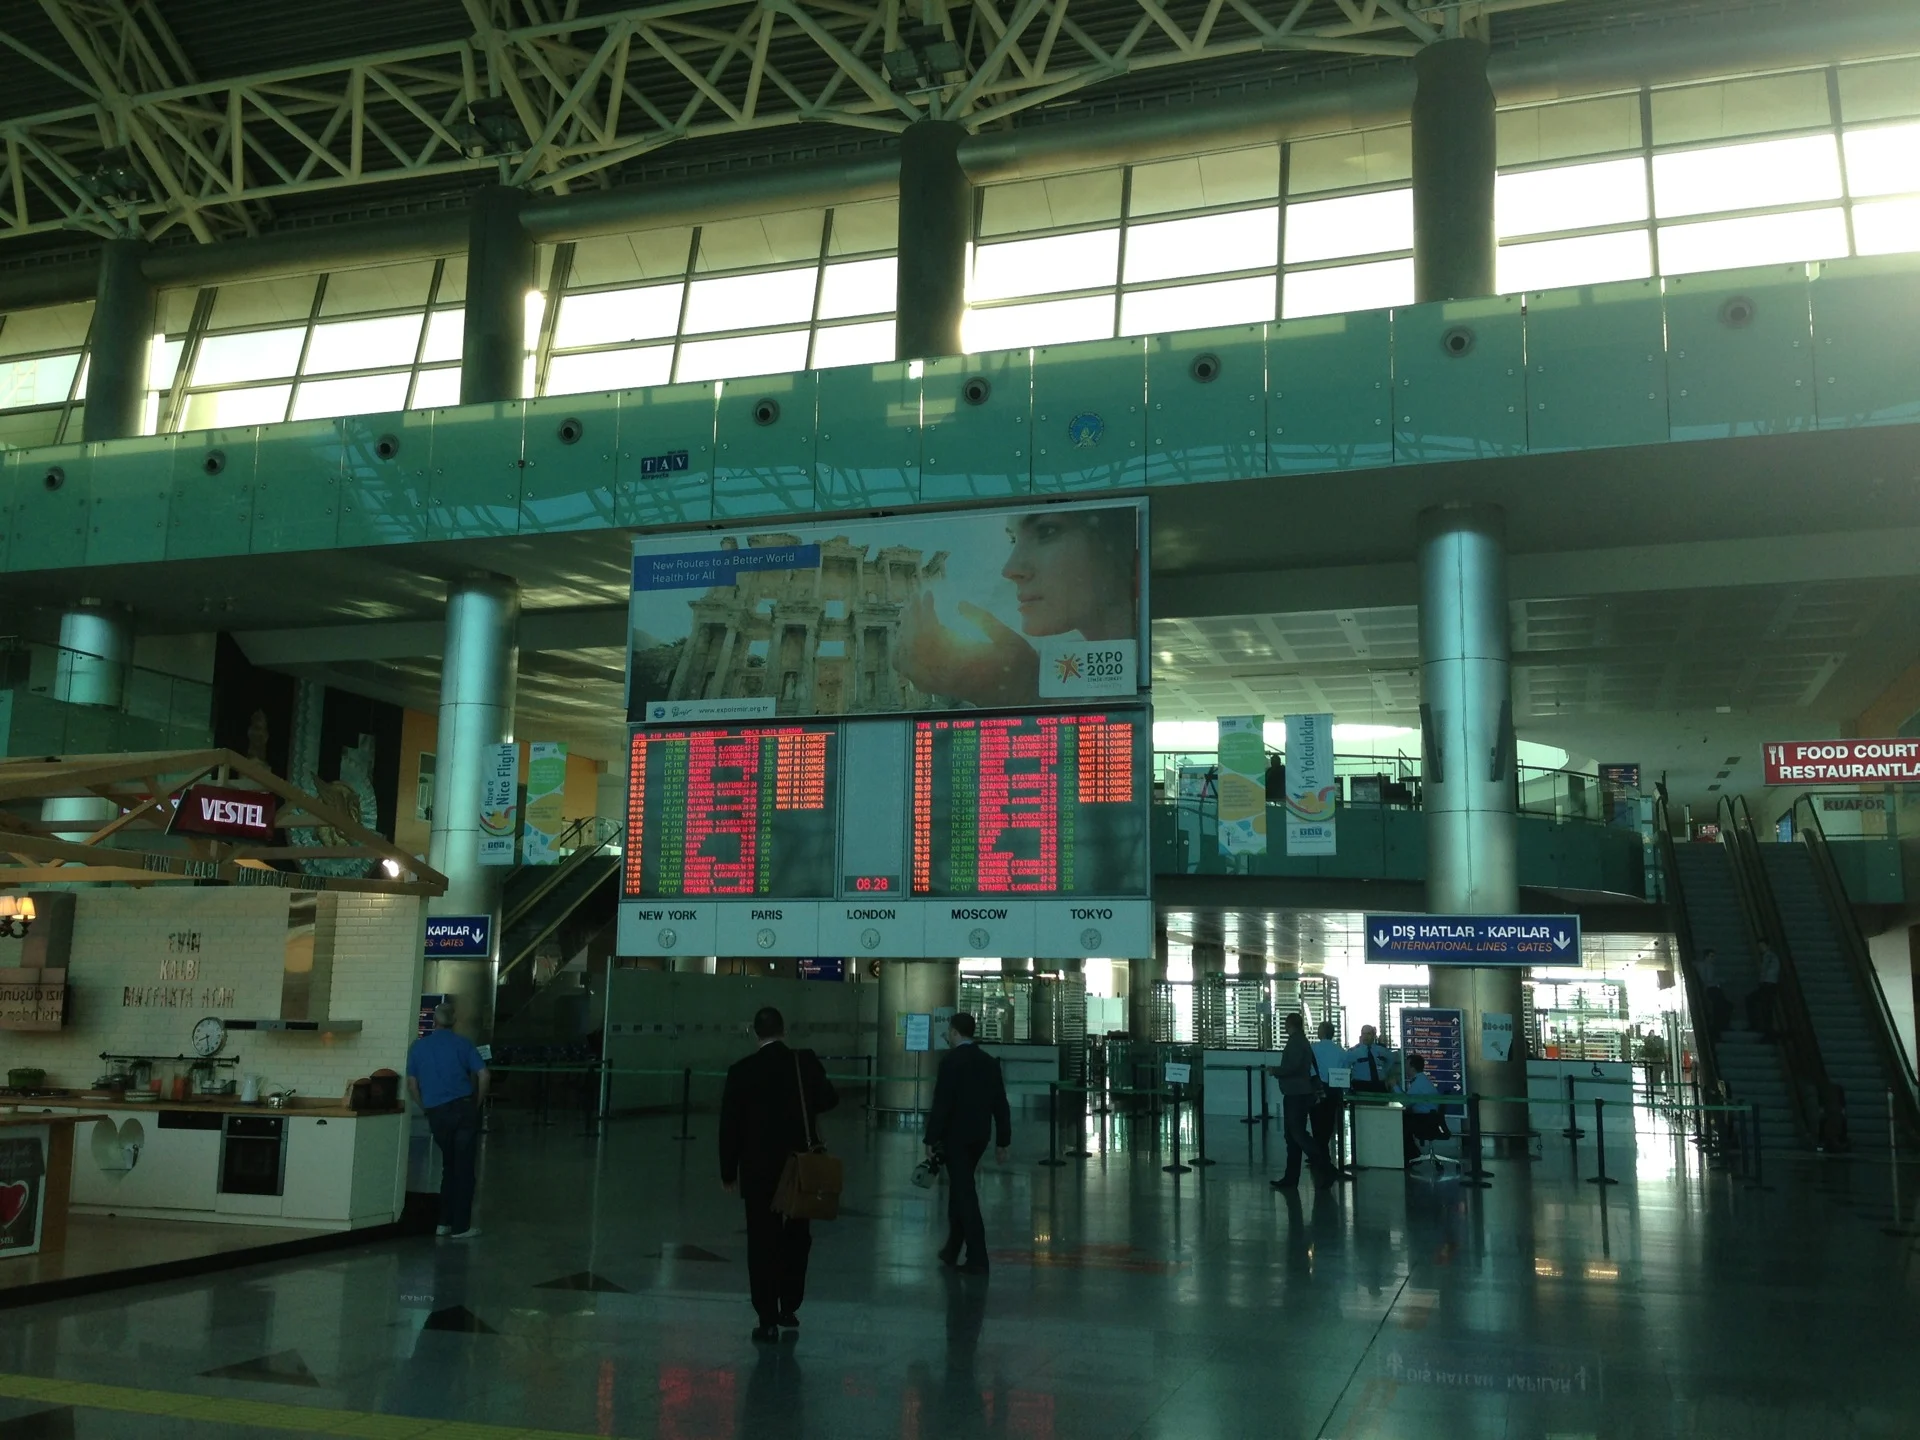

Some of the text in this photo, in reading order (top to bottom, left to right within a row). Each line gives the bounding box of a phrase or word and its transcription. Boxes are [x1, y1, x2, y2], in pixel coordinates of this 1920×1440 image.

[652, 552, 795, 570] New Routes to a Better World
[652, 570, 715, 583] Health for All
[1087, 651, 1123, 664] EXPO
[1087, 663, 1123, 676] 2020
[1105, 723, 1131, 731] LOUNGE
[1078, 732, 1095, 740] WAIT
[1105, 731, 1131, 739] LOUNGE
[1105, 739, 1131, 747] LOUNGE
[1299, 714, 1316, 772] Yolculuklar
[1797, 743, 1918, 760] FOOD COURT
[496, 745, 515, 806] Nice Flight
[1105, 786, 1131, 794] LOUNGE
[1105, 794, 1131, 802] LOUNGE
[1823, 796, 1886, 811] KUAFÖR
[201, 797, 267, 827] VESTEL
[638, 910, 697, 920] NEW YORK
[751, 910, 783, 920] PARIS
[846, 909, 896, 920] LONDON
[951, 908, 1008, 920] MOSCOW
[1070, 908, 1113, 920] TOKYO
[427, 925, 470, 936] KAPILAR
[1392, 925, 1416, 940] DIŞ
[1420, 926, 1475, 938] HATLAR
[1488, 926, 1550, 938] KAPILAR
[439, 938, 464, 947] GATES
[1390, 940, 1473, 952] INTERNATIONAL
[1476, 941, 1508, 952] LINES
[1517, 942, 1553, 953] GATES
